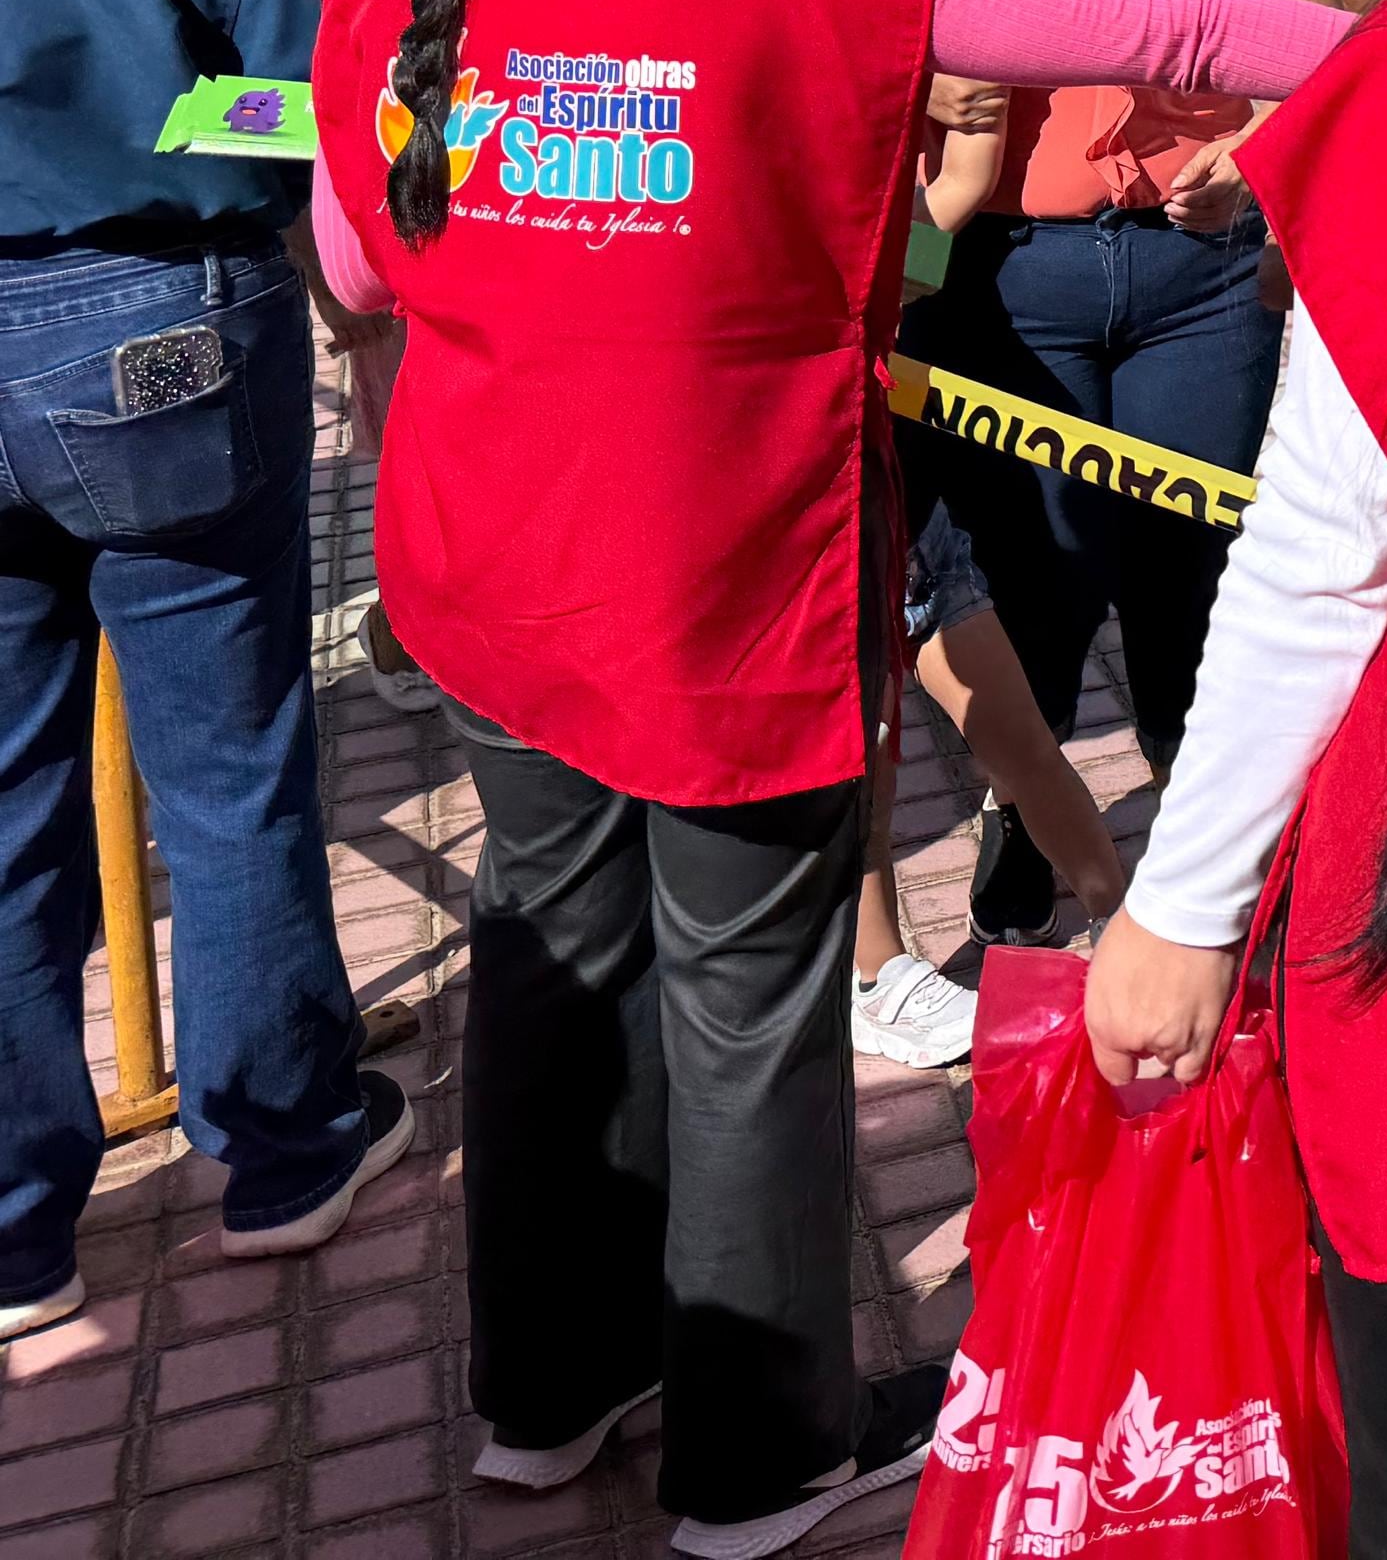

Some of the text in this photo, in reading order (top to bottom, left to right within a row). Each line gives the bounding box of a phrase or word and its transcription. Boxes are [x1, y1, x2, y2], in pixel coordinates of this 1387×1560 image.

[505, 48, 696, 90] Asociación obras
[518, 82, 681, 133] del Espíritu
[499, 117, 693, 204] Santo
[471, 203, 502, 223] niños
[505, 199, 526, 227] los
[530, 203, 573, 231] cuida
[576, 216, 597, 233] tu
[586, 206, 666, 250] Iglesia
